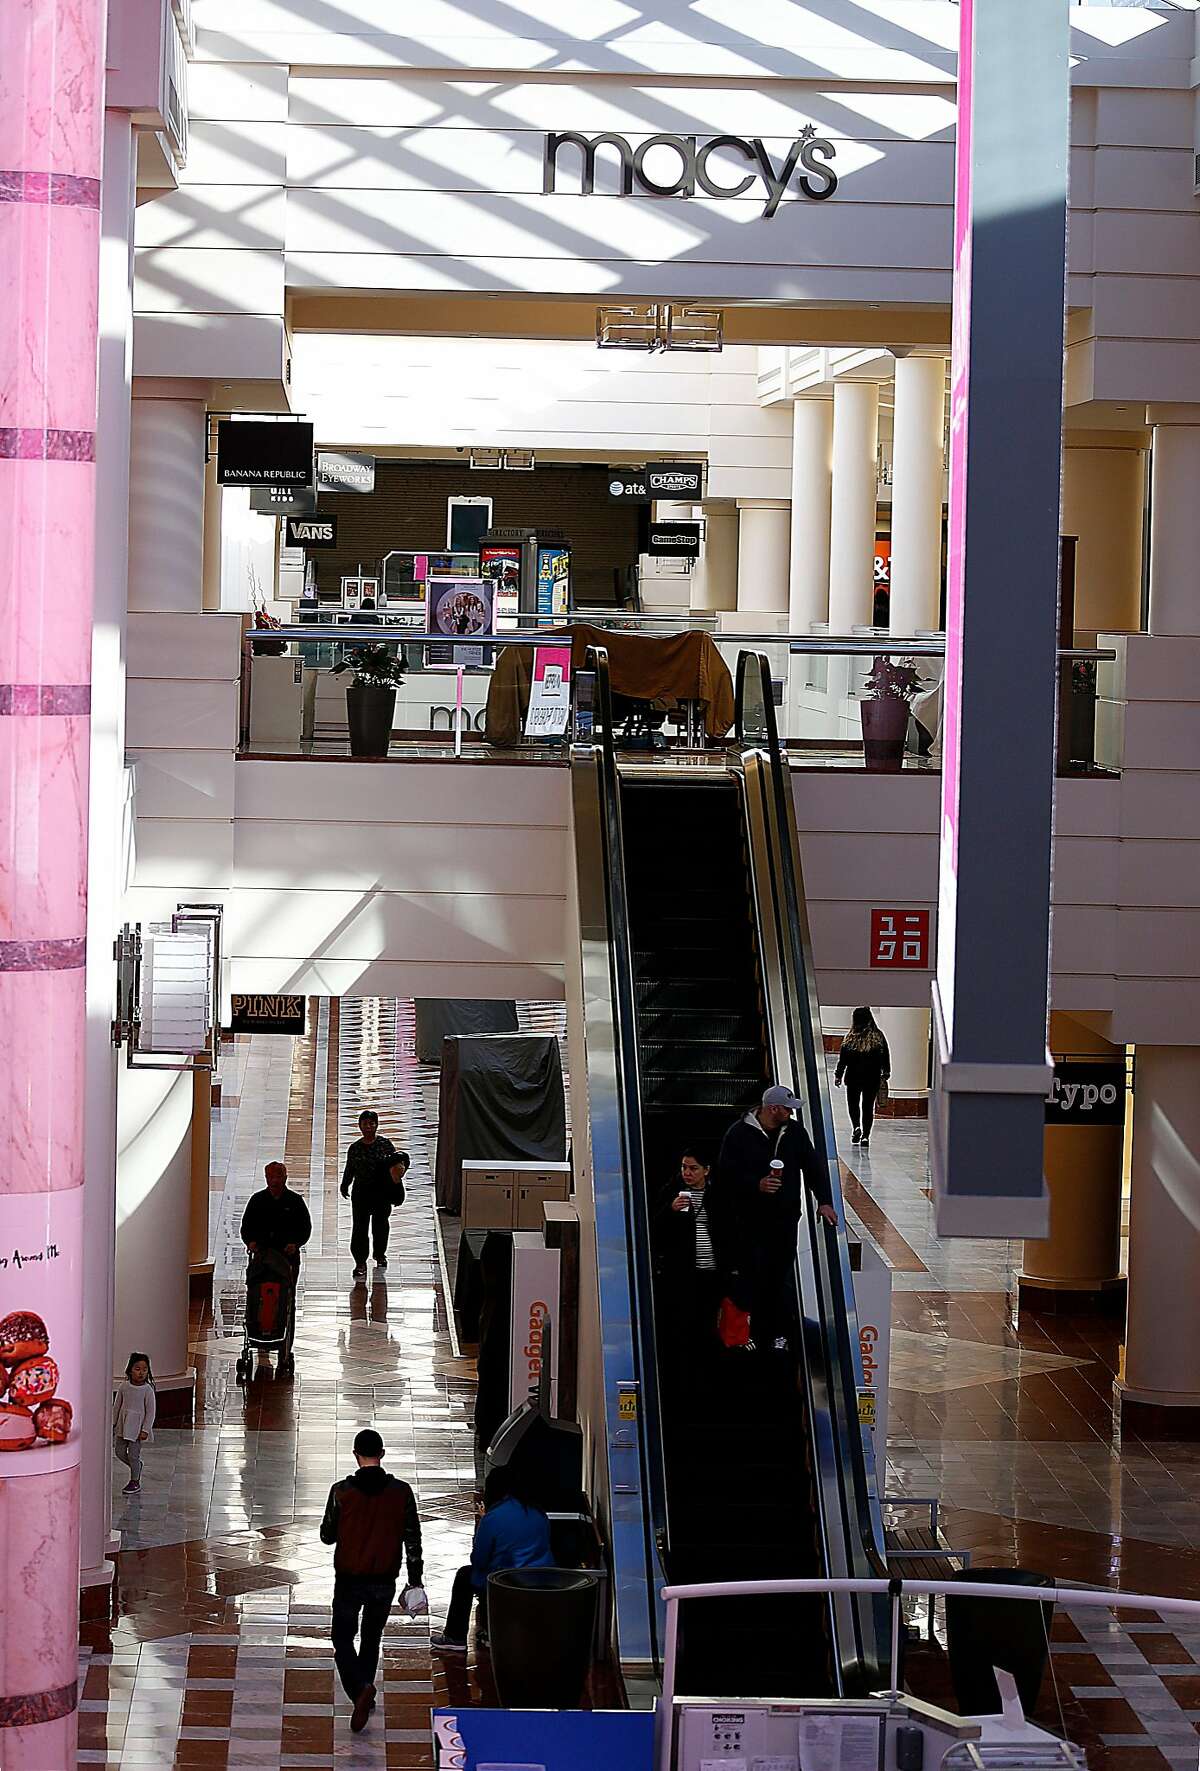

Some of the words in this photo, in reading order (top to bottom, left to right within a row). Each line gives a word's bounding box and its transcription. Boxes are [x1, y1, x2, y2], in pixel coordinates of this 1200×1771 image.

[543, 124, 838, 218] macy's
[321, 461, 372, 473] BROADWAY
[224, 469, 262, 478] BANANA
[263, 470, 306, 479] REPUBLIC
[321, 472, 372, 484] EYEWORKS
[652, 475, 696, 487] CHAMPS
[290, 522, 333, 540] VANS
[652, 534, 698, 546] GameStop
[231, 995, 301, 1018] PINK
